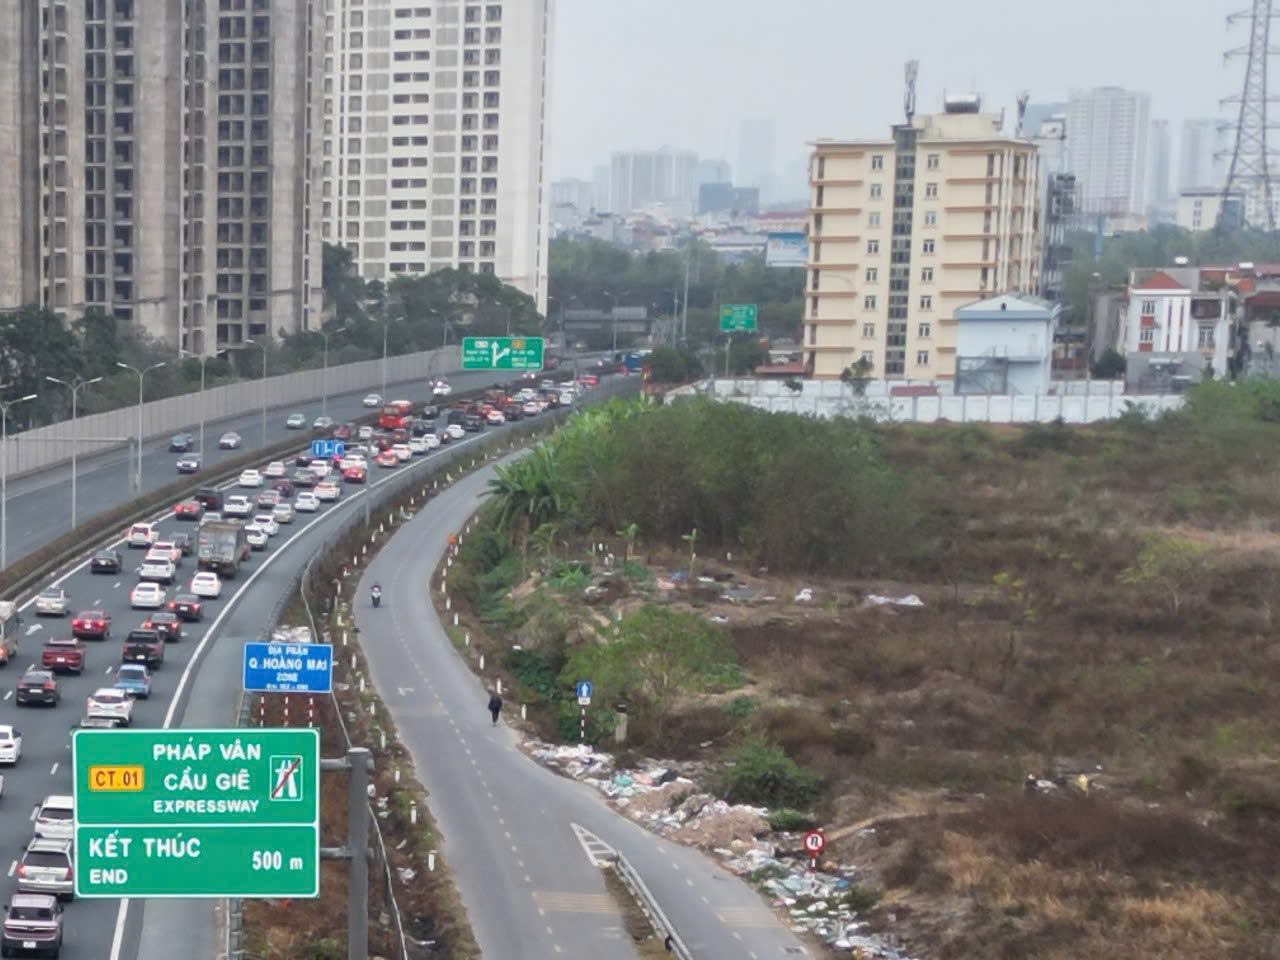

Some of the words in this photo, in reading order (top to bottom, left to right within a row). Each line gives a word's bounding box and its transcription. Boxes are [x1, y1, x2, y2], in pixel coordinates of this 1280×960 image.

[153, 737, 211, 761] PHÁP
[220, 738, 261, 761] VÂN
[95, 770, 138, 787] CT.01
[164, 766, 207, 791] CẦU
[153, 799, 259, 813] EXPRESSWAY
[89, 829, 132, 858] KẾT
[143, 832, 201, 858] THÚC
[251, 851, 282, 871] 500
[289, 856, 304, 871] m
[89, 869, 128, 885] END
